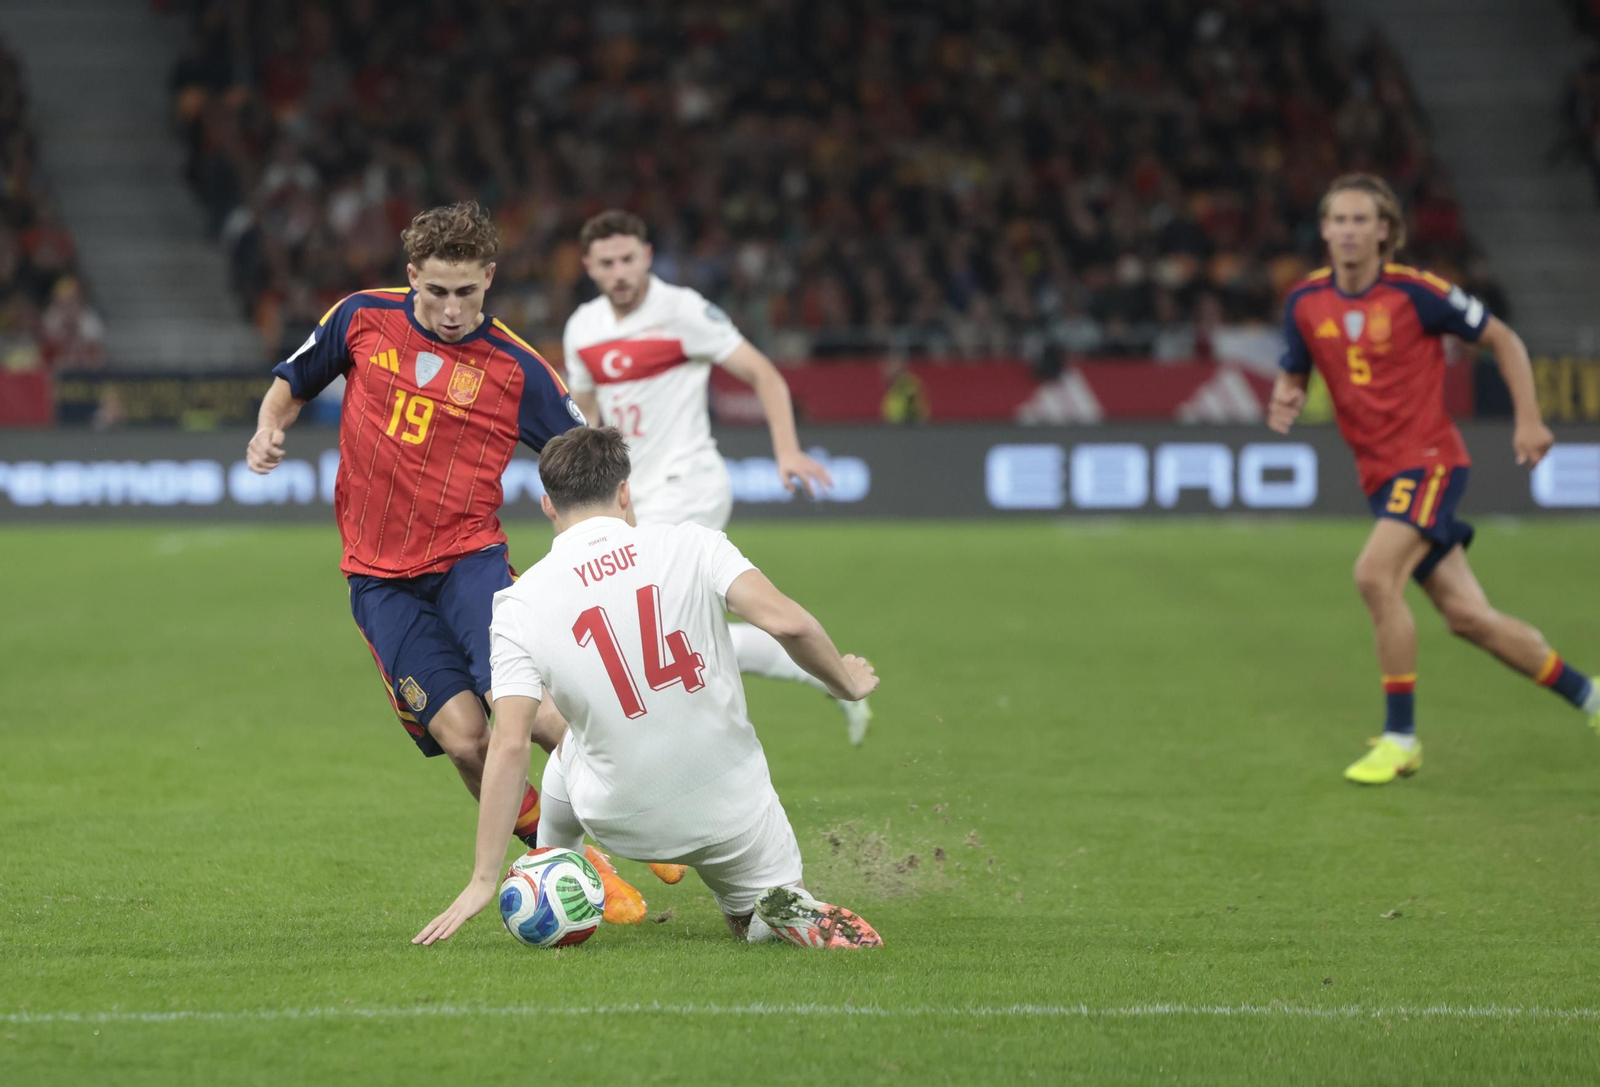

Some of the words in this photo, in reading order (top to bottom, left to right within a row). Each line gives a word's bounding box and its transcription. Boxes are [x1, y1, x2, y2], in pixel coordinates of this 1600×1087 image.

[1347, 345, 1373, 385] 5
[386, 389, 434, 444] 19
[1386, 477, 1417, 513] 5
[573, 544, 638, 587] YUSUF
[572, 584, 706, 720] 14
